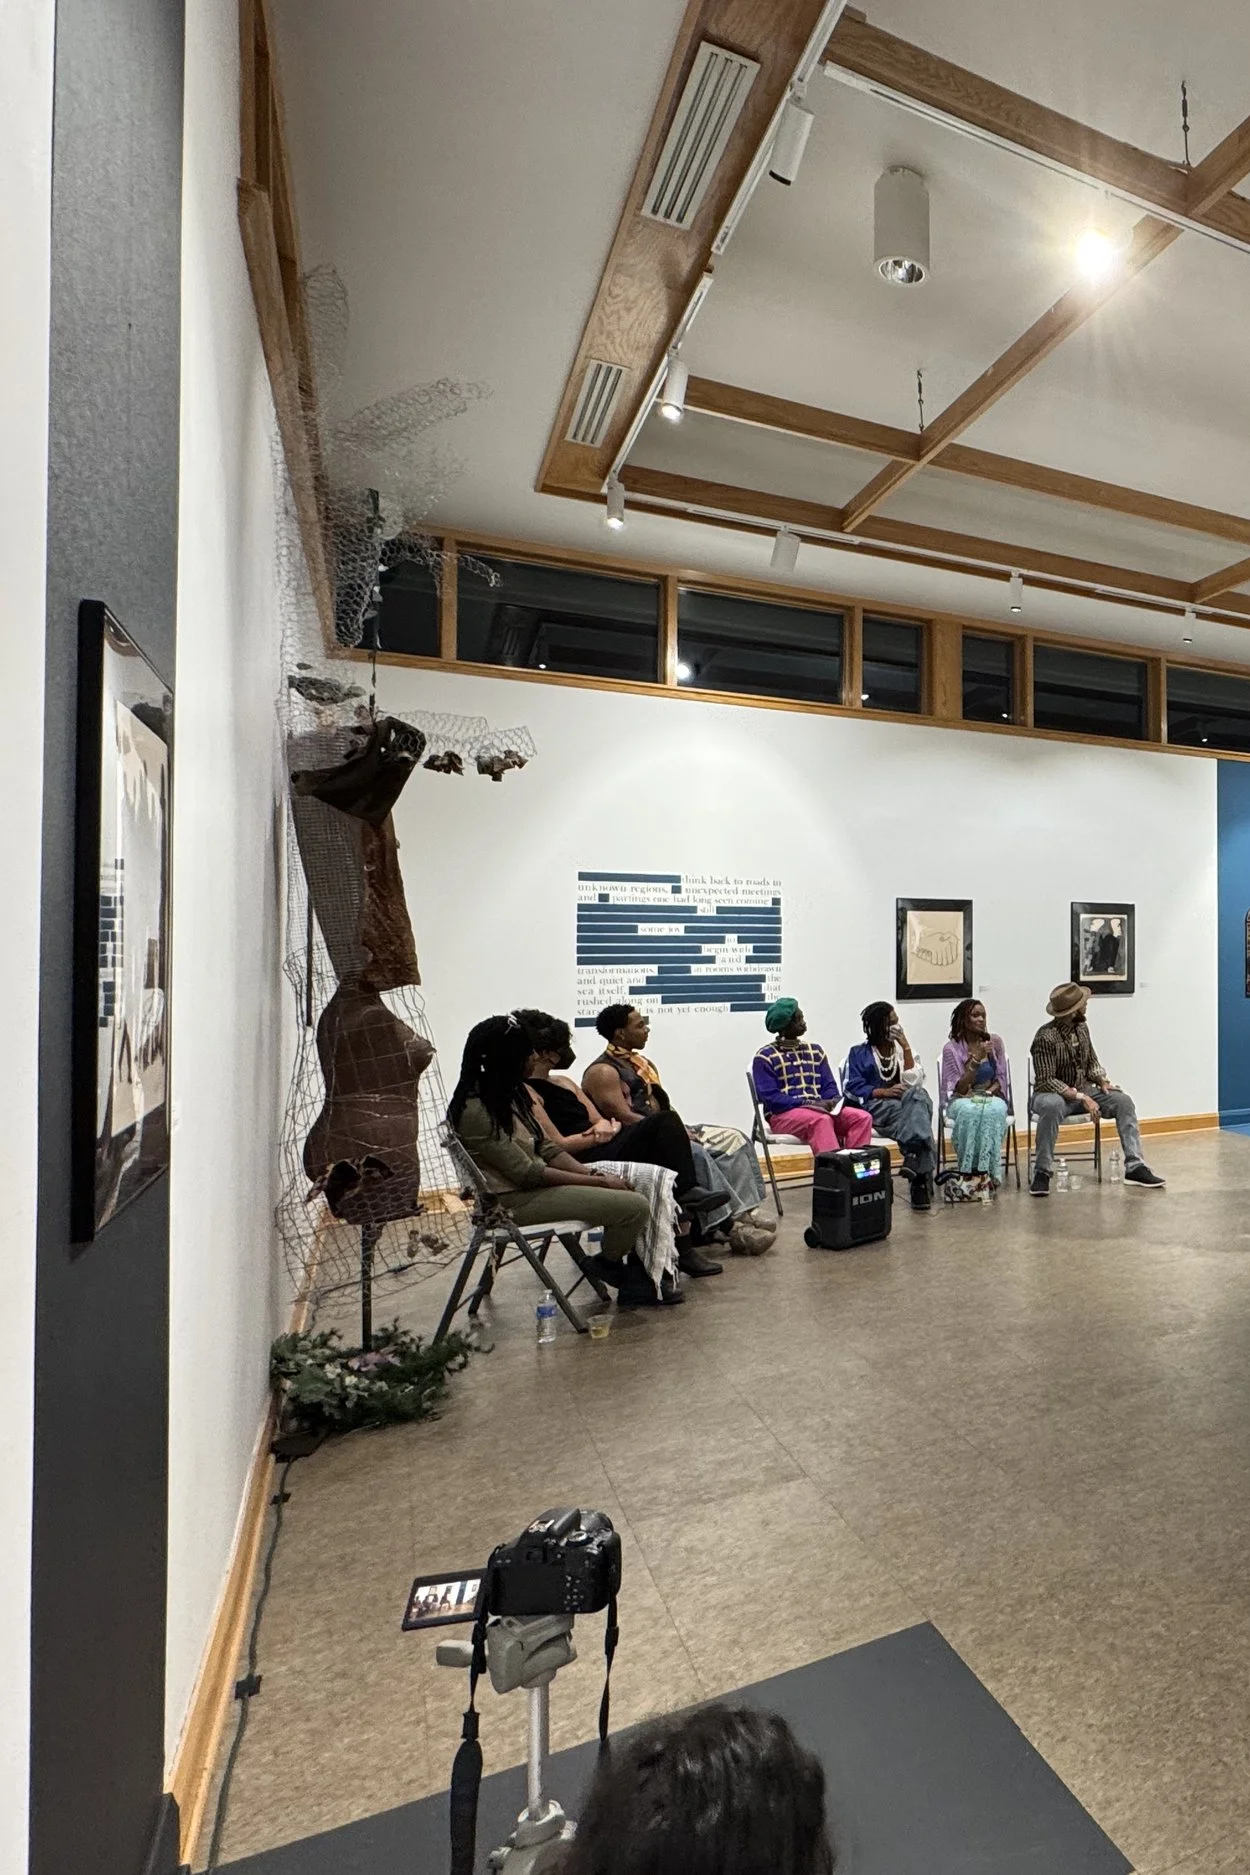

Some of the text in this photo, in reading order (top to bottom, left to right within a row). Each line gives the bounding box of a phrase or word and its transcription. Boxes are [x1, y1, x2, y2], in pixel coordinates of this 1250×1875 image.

[710, 876, 730, 885] back
[746, 878, 770, 886] roads
[578, 883, 627, 892] unknown
[684, 886, 738, 896] unexpected
[742, 888, 782, 896] meetings
[578, 893, 596, 902] and
[612, 895, 650, 904] partings
[693, 896, 711, 905] long
[704, 945, 729, 954] begin
[736, 964, 782, 973] withdrawn
[577, 976, 596, 985] and
[599, 976, 624, 985] quiet
[768, 974, 782, 982] the
[577, 996, 612, 1006] rushed
[616, 996, 643, 1005] along
[676, 1006, 690, 1014] yet
[694, 1004, 729, 1013] enough
[852, 1190, 886, 1206] ION
